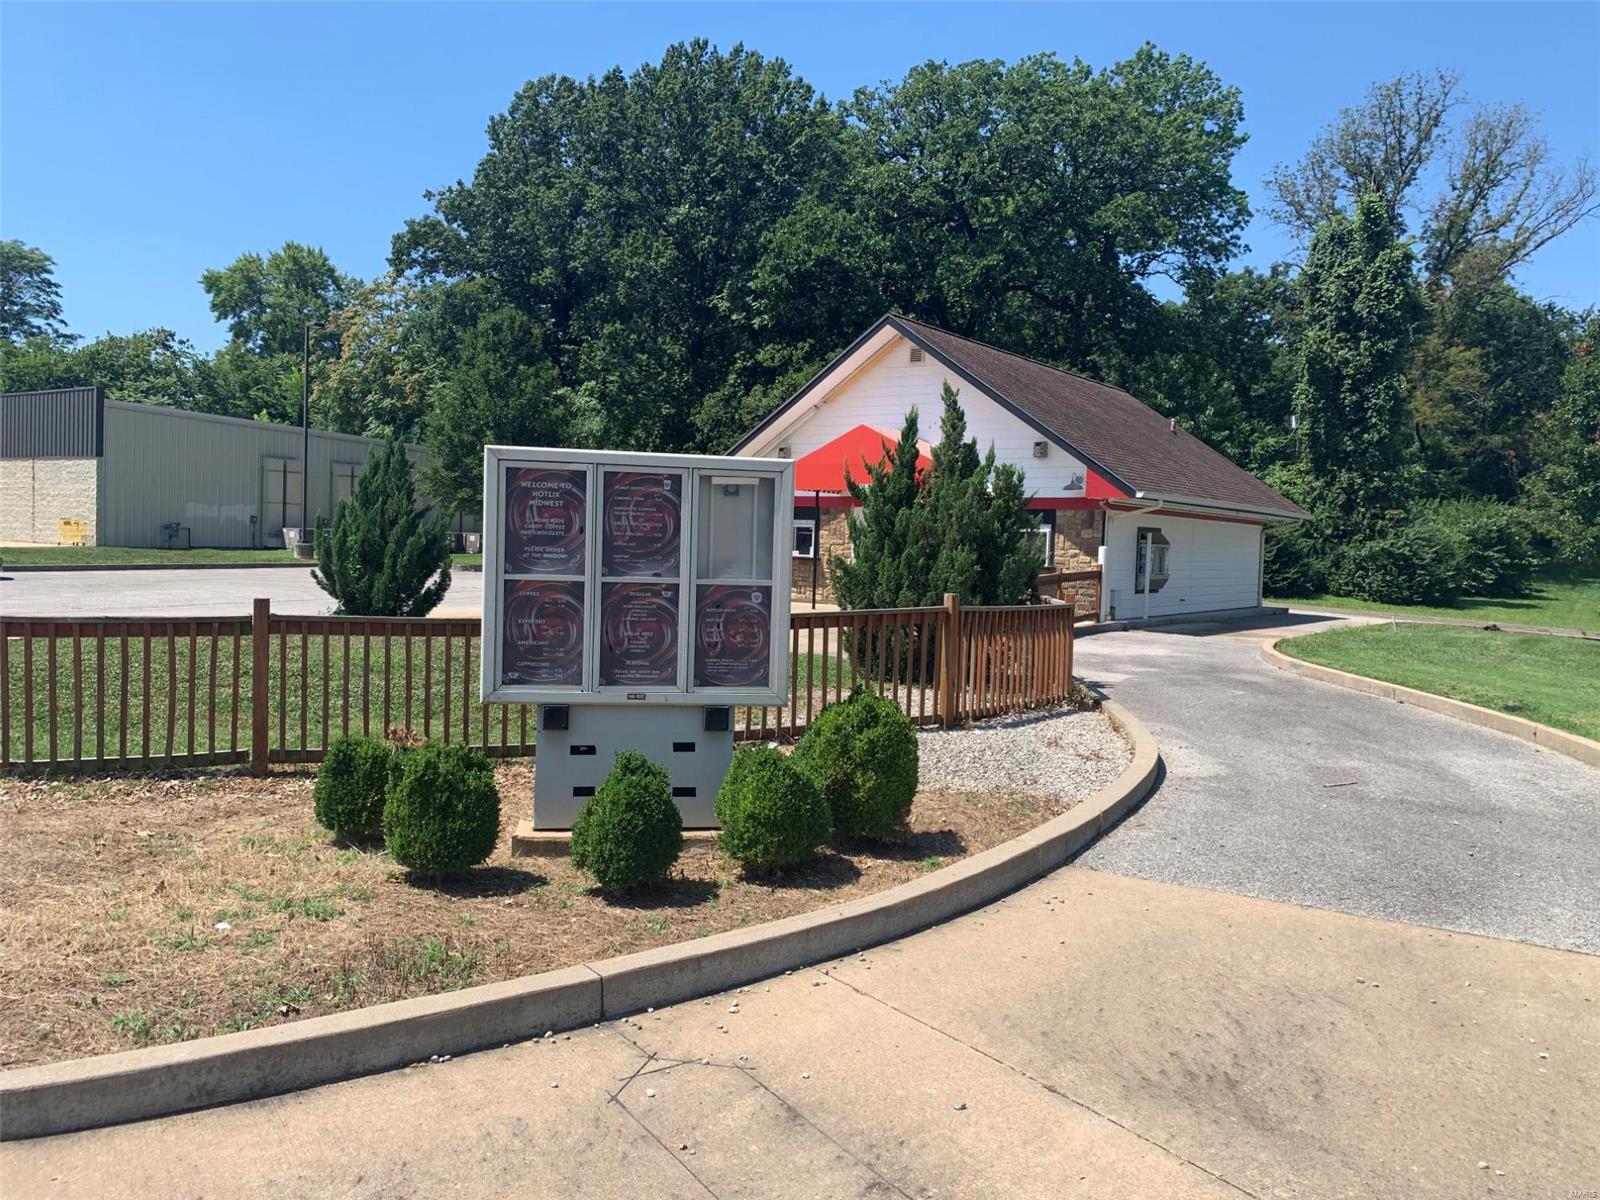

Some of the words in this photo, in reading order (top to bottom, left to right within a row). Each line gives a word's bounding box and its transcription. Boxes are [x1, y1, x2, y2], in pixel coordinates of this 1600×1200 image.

[520, 481, 558, 489] WELCOME
[561, 482, 572, 490] TO
[532, 490, 560, 498] HOTLIX
[528, 499, 564, 507] MIDWEST
